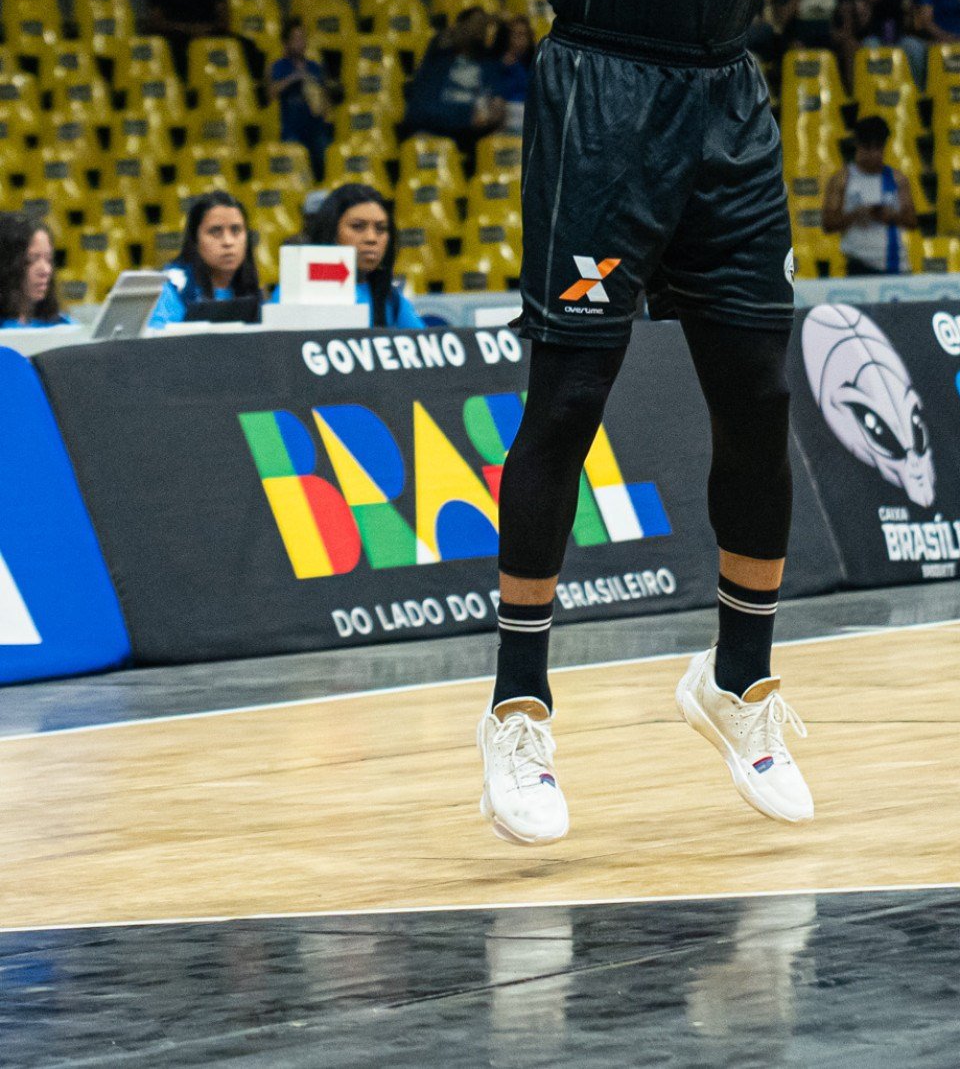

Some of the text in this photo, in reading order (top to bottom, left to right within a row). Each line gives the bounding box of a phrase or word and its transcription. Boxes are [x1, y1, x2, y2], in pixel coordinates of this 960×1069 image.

[302, 330, 523, 376] GOVERNO DO
[331, 609, 373, 637] DO
[375, 597, 446, 632] LADO
[446, 591, 488, 620] DO
[555, 567, 677, 611] BRASILEIRO
